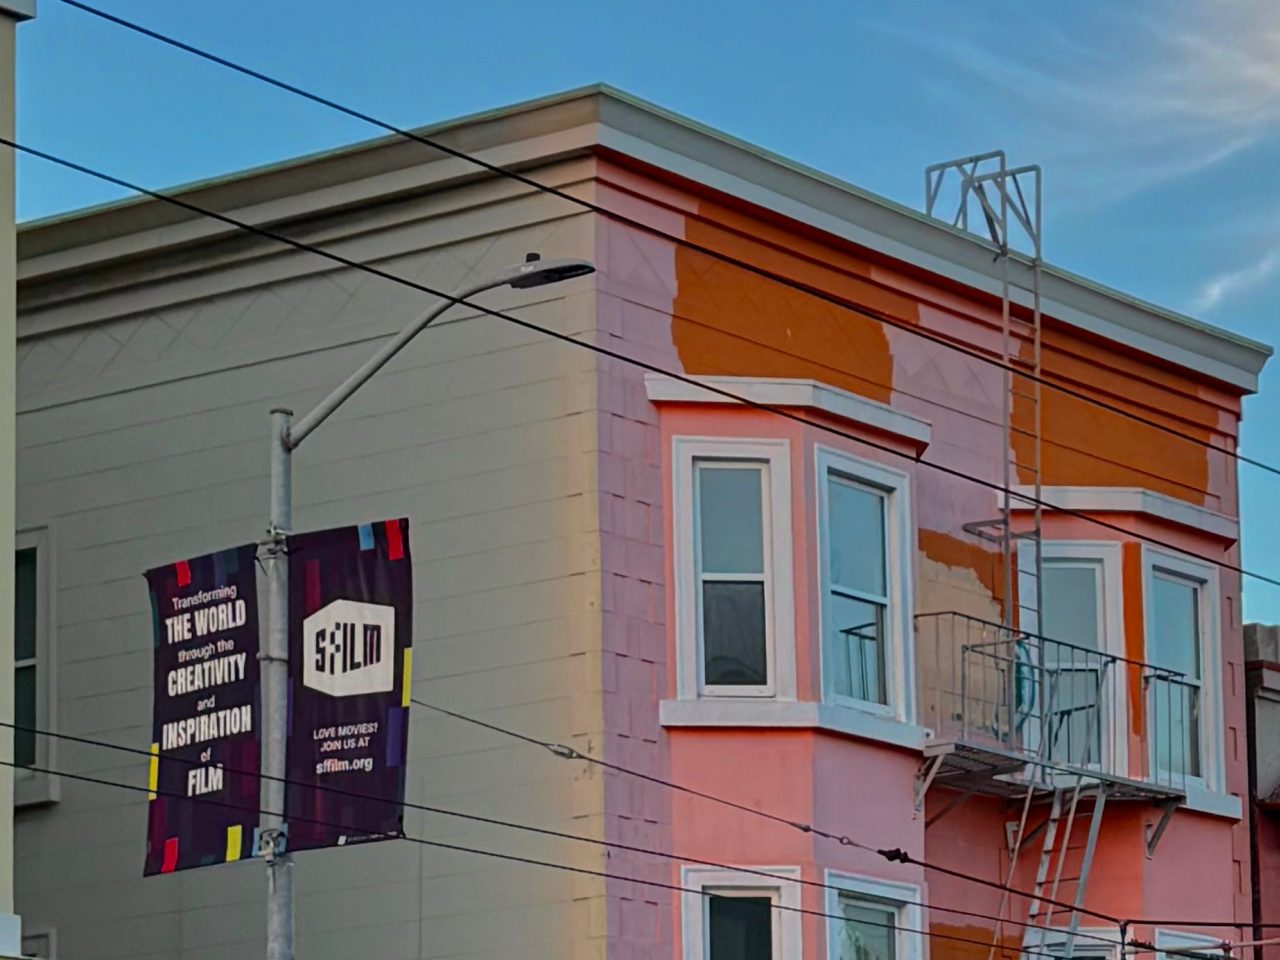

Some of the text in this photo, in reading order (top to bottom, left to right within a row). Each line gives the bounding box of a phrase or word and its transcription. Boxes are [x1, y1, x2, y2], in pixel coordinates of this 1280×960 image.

[172, 585, 237, 610] Transforming
[165, 600, 247, 645] THE WORLD
[178, 638, 235, 664] through the
[168, 653, 247, 697] CREATIVITY
[197, 695, 215, 710] and
[162, 705, 252, 750] INSPIRATION
[313, 721, 379, 741] LOVE MOVIES?
[200, 748, 211, 763] of
[320, 736, 370, 753] JOIN US AT
[316, 756, 373, 774] sffilm.org
[187, 764, 223, 797] FILM
